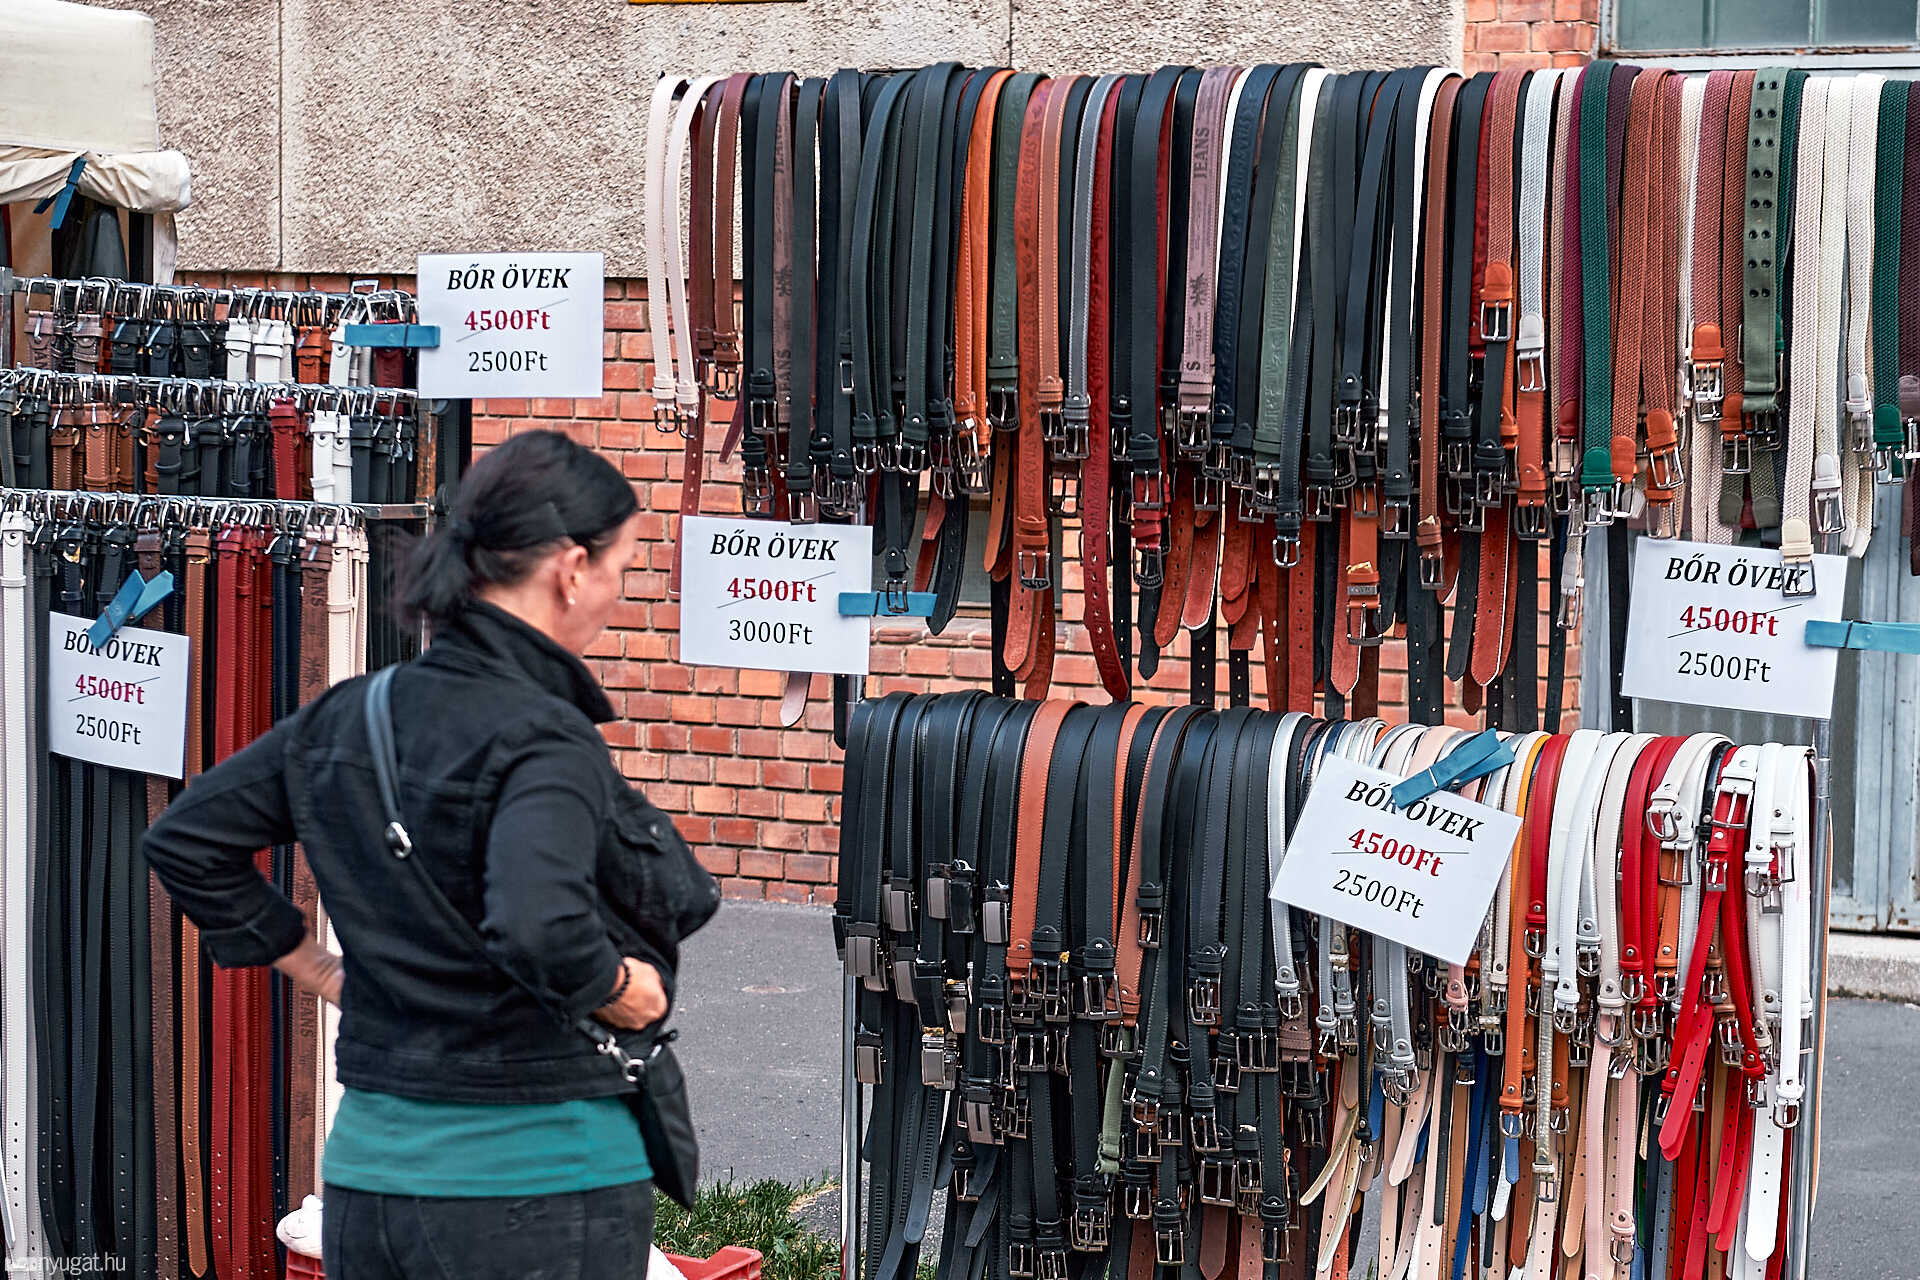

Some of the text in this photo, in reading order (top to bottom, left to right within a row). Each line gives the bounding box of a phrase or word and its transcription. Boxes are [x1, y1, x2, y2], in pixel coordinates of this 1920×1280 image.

[1193, 127, 1210, 179] JEANS
[447, 264, 572, 290] BŐR ÖVEK
[464, 309, 551, 331] 4500Ft
[468, 350, 548, 372] 2500Ft
[710, 529, 840, 561] BŐR ÖVEK
[1664, 553, 1809, 592] BŐR ÖVEK
[727, 577, 817, 602] 4500Ft
[729, 619, 813, 645] 3000Ft
[1679, 605, 1779, 637] 4500Ft
[106, 635, 164, 667] ÖVEK
[1678, 651, 1772, 682] 2500Ft
[75, 674, 145, 704] 4500Ft
[76, 714, 141, 745] 2500Ft
[1406, 796, 1485, 842] ÖVEK
[1348, 828, 1444, 877] 4500Ft
[1332, 869, 1425, 918] 2500Ft
